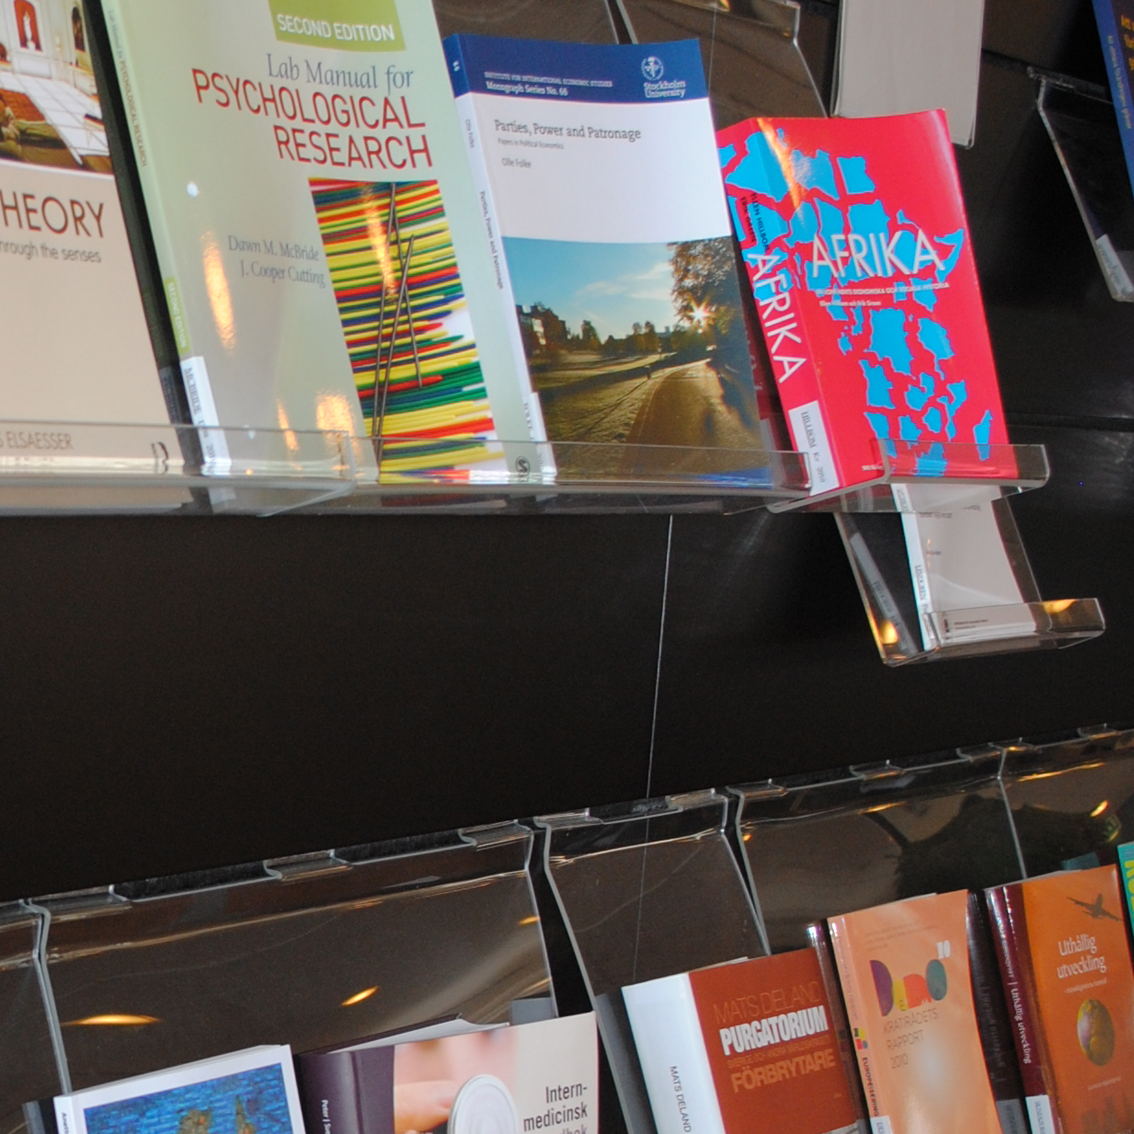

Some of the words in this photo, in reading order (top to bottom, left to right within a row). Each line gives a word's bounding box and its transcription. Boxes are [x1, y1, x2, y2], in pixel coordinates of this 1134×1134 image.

[276, 13, 332, 39] SECOND
[334, 22, 395, 41] EDITION
[266, 53, 300, 81] Lab
[305, 59, 379, 89] Manual
[385, 64, 413, 95] for
[643, 79, 686, 90] Stockholm
[191, 67, 426, 129] PSYCHOLOGICAL
[644, 88, 686, 98] University
[494, 119, 532, 136] Parties,
[533, 123, 564, 137] Power
[566, 125, 586, 138] and
[587, 127, 641, 142] Patronage
[272, 125, 433, 169] RESEARCH
[40, 243, 59, 260] the
[61, 249, 103, 263] senses
[227, 235, 262, 253] Dawn
[280, 240, 319, 262] McBride
[812, 229, 946, 278] AFRIKA
[250, 261, 287, 282] Cooper
[287, 265, 326, 288] Cutting
[747, 252, 806, 384] AFRIKA
[7, 430, 73, 450] ELSAESSER
[1058, 933, 1097, 957] Uthållig
[1056, 955, 1107, 979] utveckling
[713, 994, 760, 1024] MATS
[760, 981, 821, 1015] DELAND
[719, 1005, 828, 1056] PURGATORIUM
[886, 1029, 923, 1051] RAPPORT
[731, 1048, 836, 1093] FÖRBRYTARE
[545, 1082, 588, 1104] Intern-
[670, 1065, 682, 1092] MATS
[676, 1093, 692, 1133] DELAND
[522, 1102, 588, 1133] medicinsk
